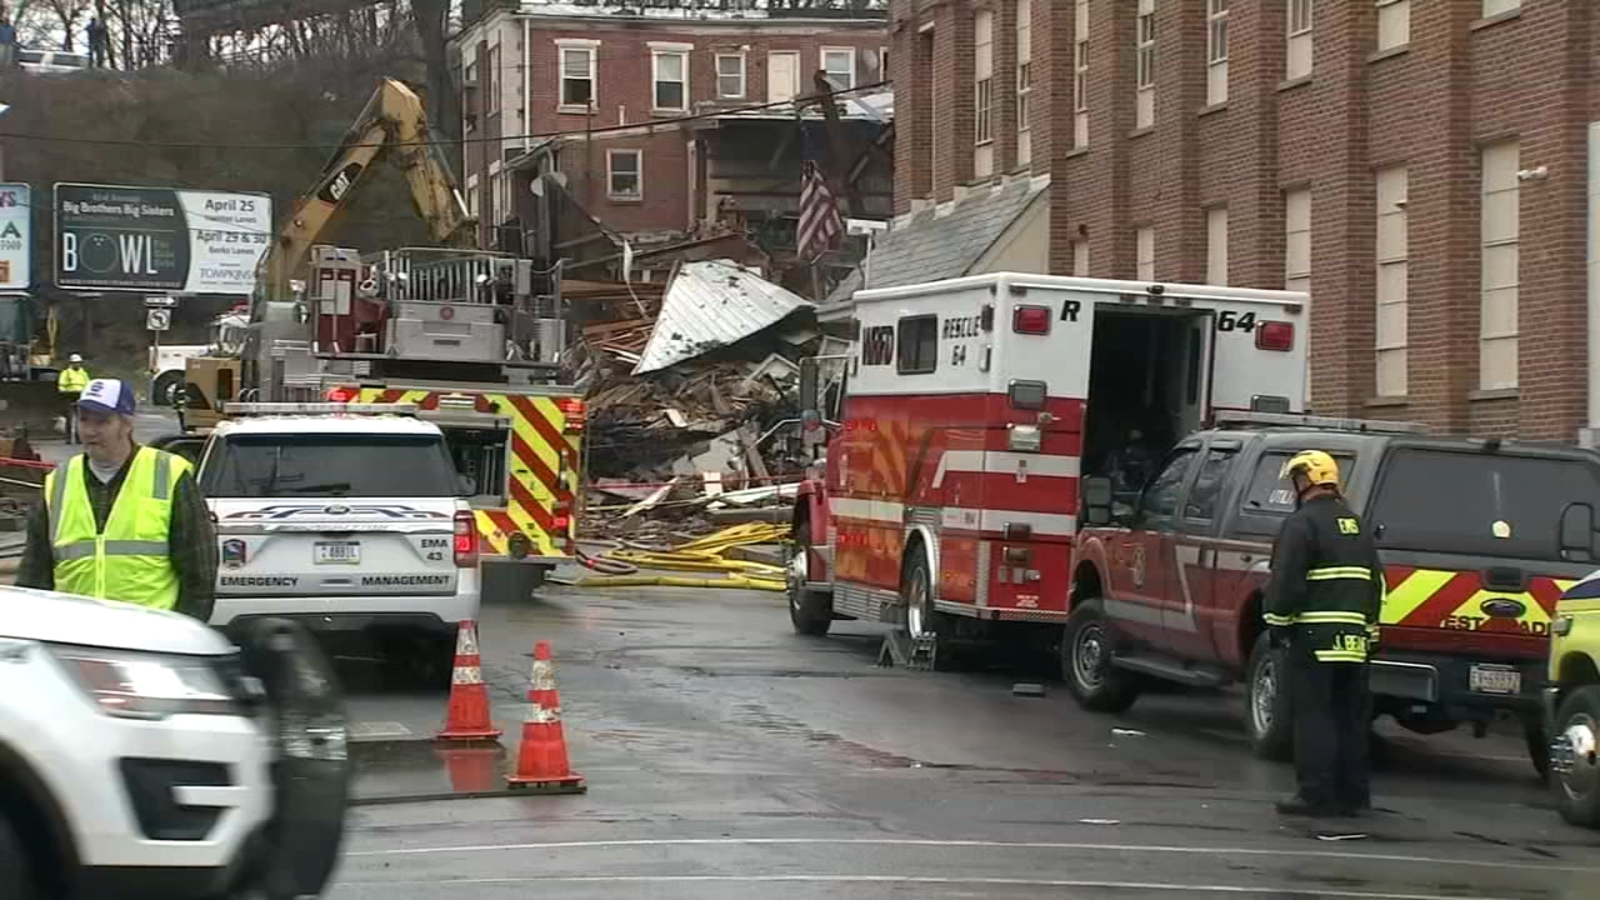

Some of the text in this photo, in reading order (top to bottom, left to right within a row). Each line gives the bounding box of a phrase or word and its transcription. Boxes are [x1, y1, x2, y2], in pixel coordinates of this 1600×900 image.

[330, 171, 350, 200] CAT
[63, 200, 174, 218] Big Brothers Big Sisters
[205, 199, 255, 212] April 25
[1060, 299, 1256, 333] R 64
[942, 316, 981, 340] RESCUE
[951, 345, 967, 366] 64
[421, 538, 448, 549] EMA
[426, 552, 443, 561] 43
[220, 575, 450, 587] EMERGENCY MANAGEMENT
